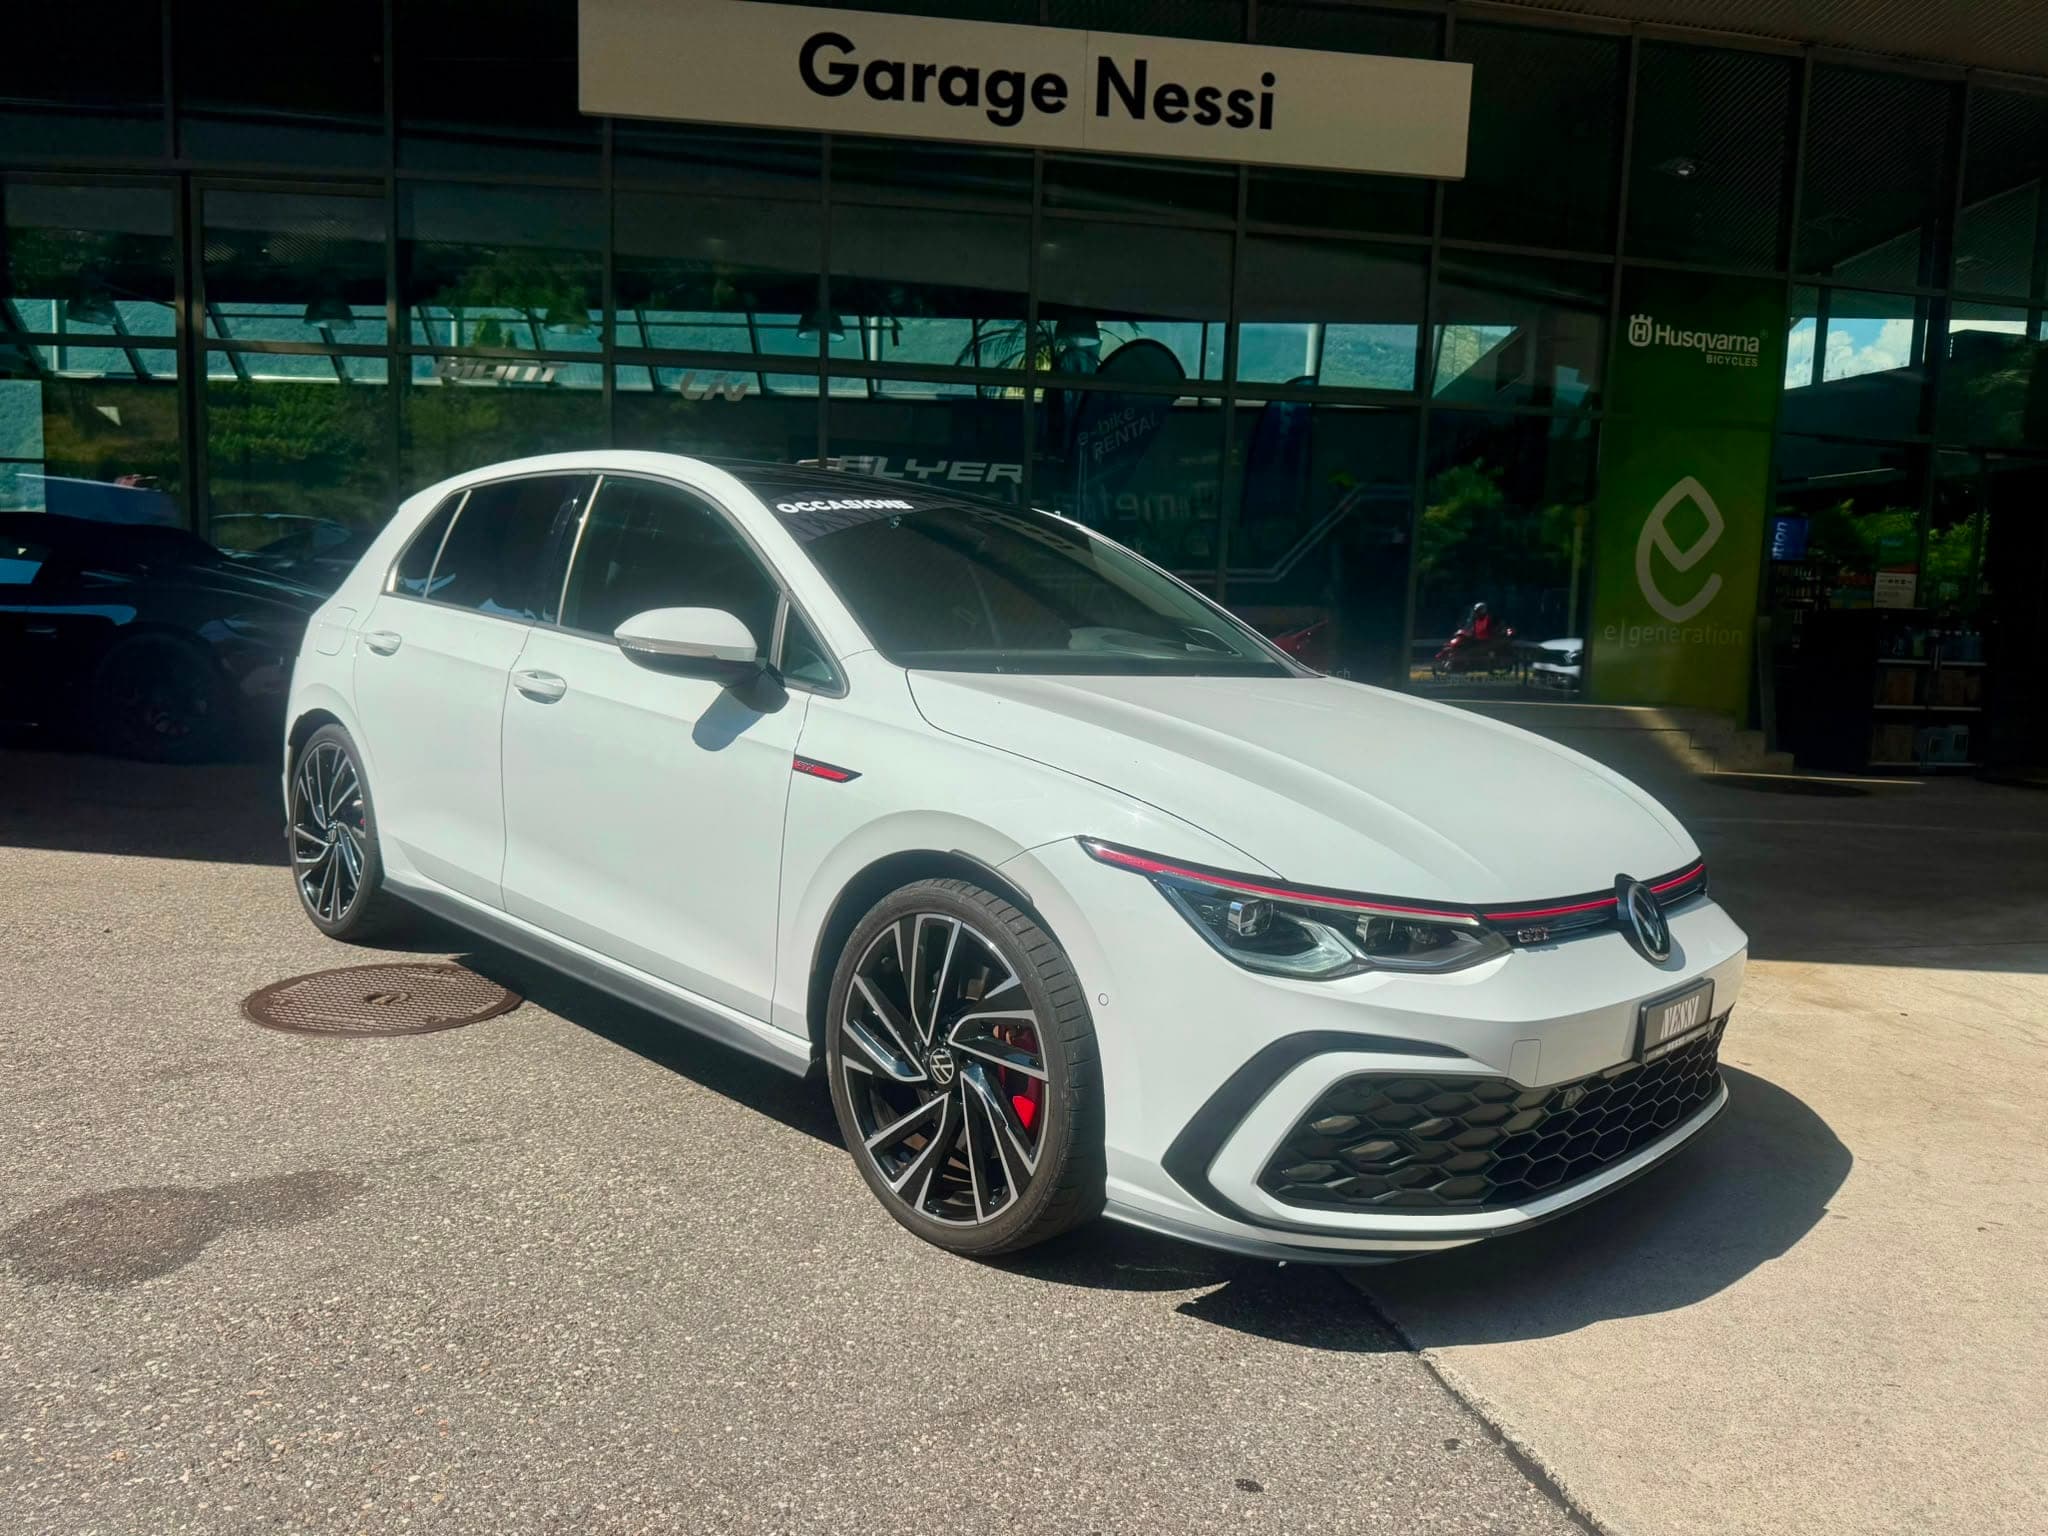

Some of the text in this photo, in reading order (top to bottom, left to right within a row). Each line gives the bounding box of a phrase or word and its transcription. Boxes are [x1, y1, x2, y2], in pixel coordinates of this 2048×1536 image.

[798, 30, 1276, 131] Garage Nessi
[1655, 323, 1760, 353] Husqvarna
[1706, 354, 1759, 367] BICYCLES
[1091, 411, 1161, 461] RENTAL
[838, 454, 1025, 485] FLYER
[775, 499, 915, 514] OCCASIONE
